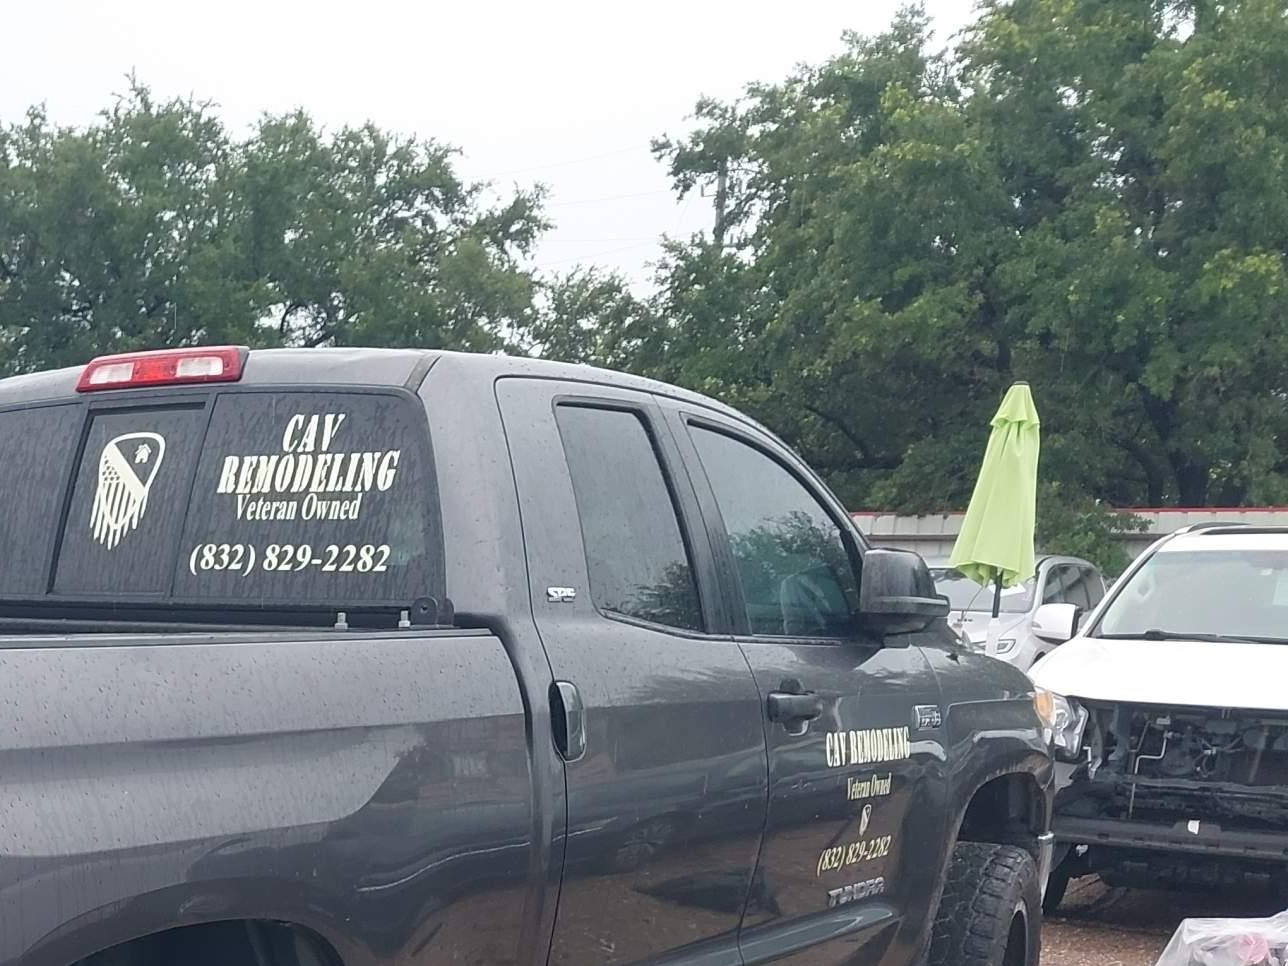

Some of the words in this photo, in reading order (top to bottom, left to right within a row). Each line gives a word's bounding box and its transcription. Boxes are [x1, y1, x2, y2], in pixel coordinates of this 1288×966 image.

[282, 413, 346, 453] CAV
[216, 450, 401, 494] REMODELING
[236, 494, 298, 521] Veteran
[301, 493, 363, 521] Owned
[189, 543, 256, 577] (832)
[262, 544, 392, 573] 829-2282
[826, 731, 848, 768] CAV
[848, 726, 911, 765] REMODELING
[847, 776, 871, 801] Veteran
[870, 772, 892, 797] Owned
[816, 846, 845, 878] (832)
[845, 835, 892, 867] 829-2282
[827, 876, 886, 908] TUNDRA
